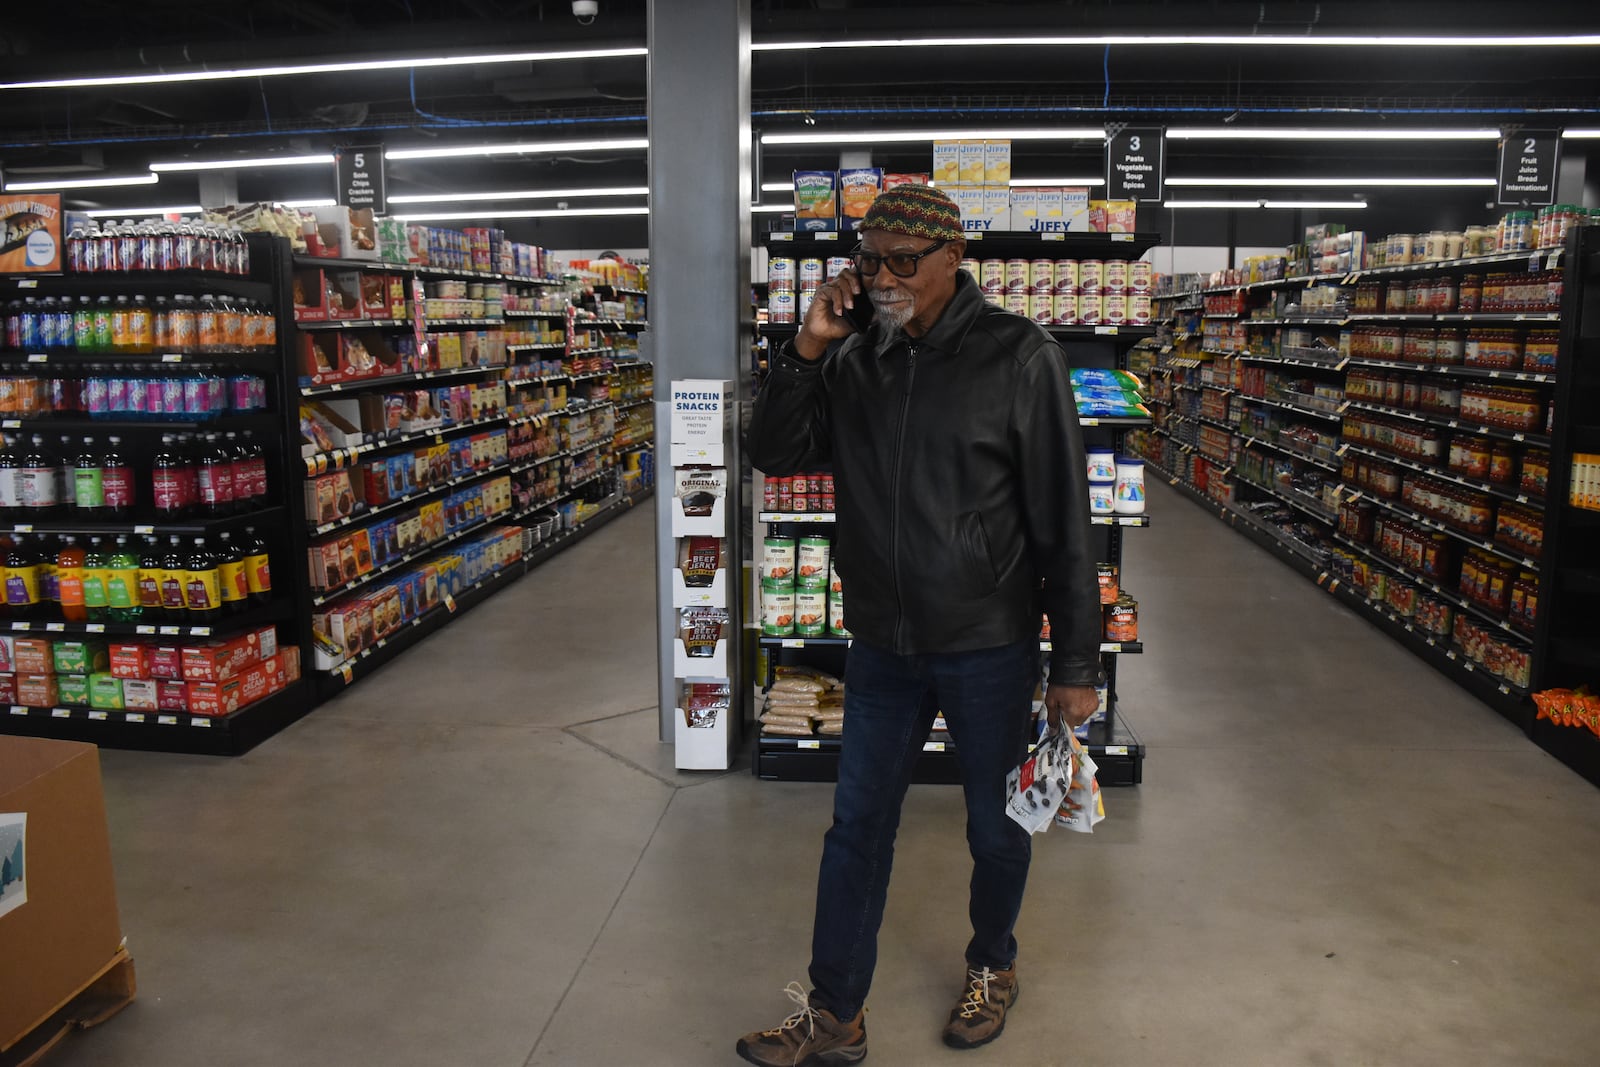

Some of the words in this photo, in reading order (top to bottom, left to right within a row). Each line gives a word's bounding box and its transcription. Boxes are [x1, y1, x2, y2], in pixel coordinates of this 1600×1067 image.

[1130, 136, 1140, 150] 3
[1524, 138, 1536, 153] 2
[354, 153, 364, 168] 5
[1116, 164, 1152, 172] Vegetables
[1126, 172, 1144, 181] Soup
[1122, 181, 1146, 190] Spices
[8, 201, 28, 214] YOUR
[30, 202, 57, 220] THIRST
[960, 220, 992, 230] IFFY
[247, 671, 260, 681] RED
[243, 676, 266, 690] CREAM
